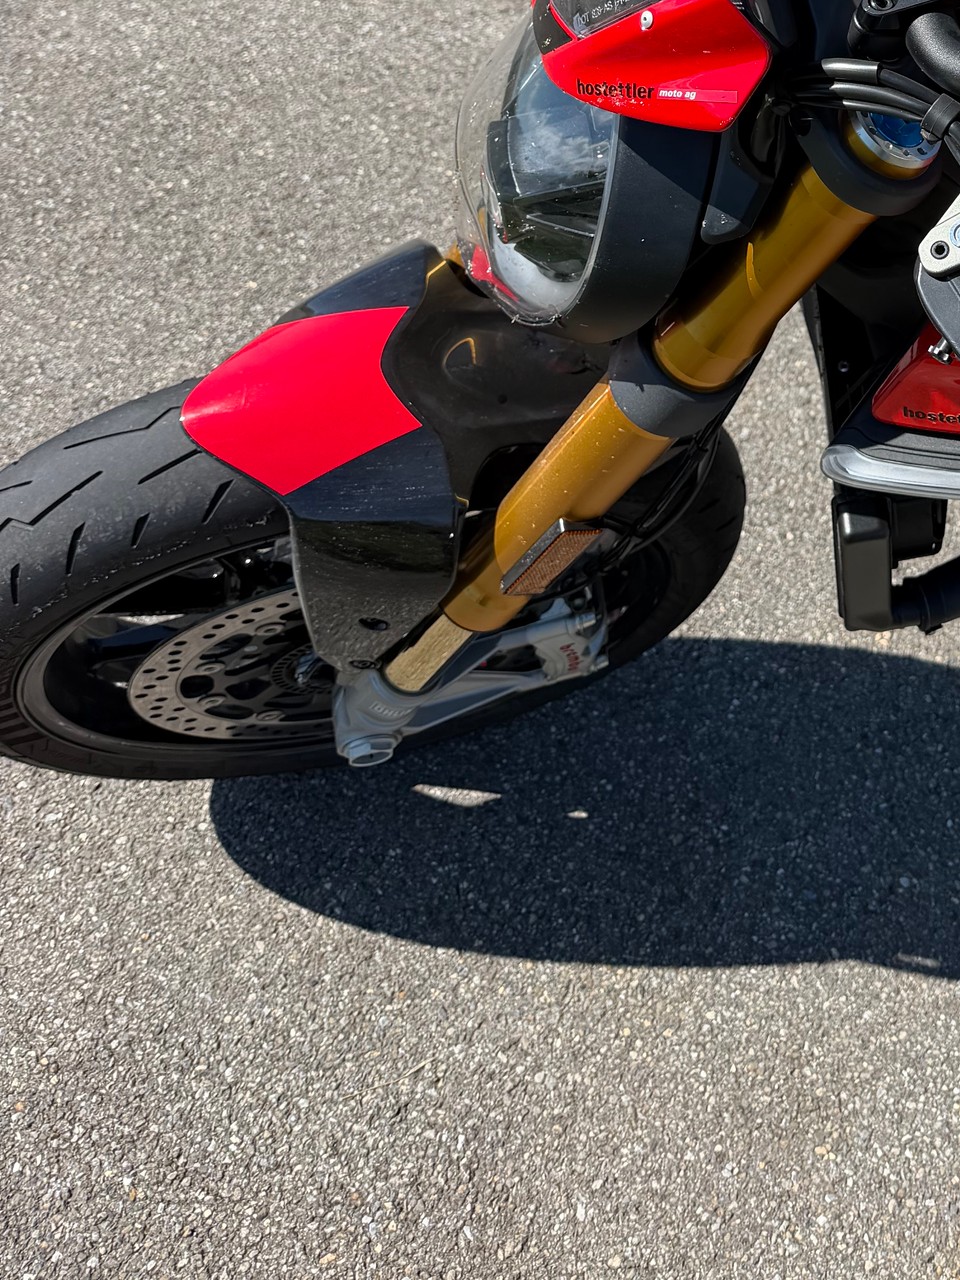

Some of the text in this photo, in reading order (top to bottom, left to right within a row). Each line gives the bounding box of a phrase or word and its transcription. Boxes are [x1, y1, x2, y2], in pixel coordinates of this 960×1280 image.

[576, 78, 697, 100] hostettler moto ag
